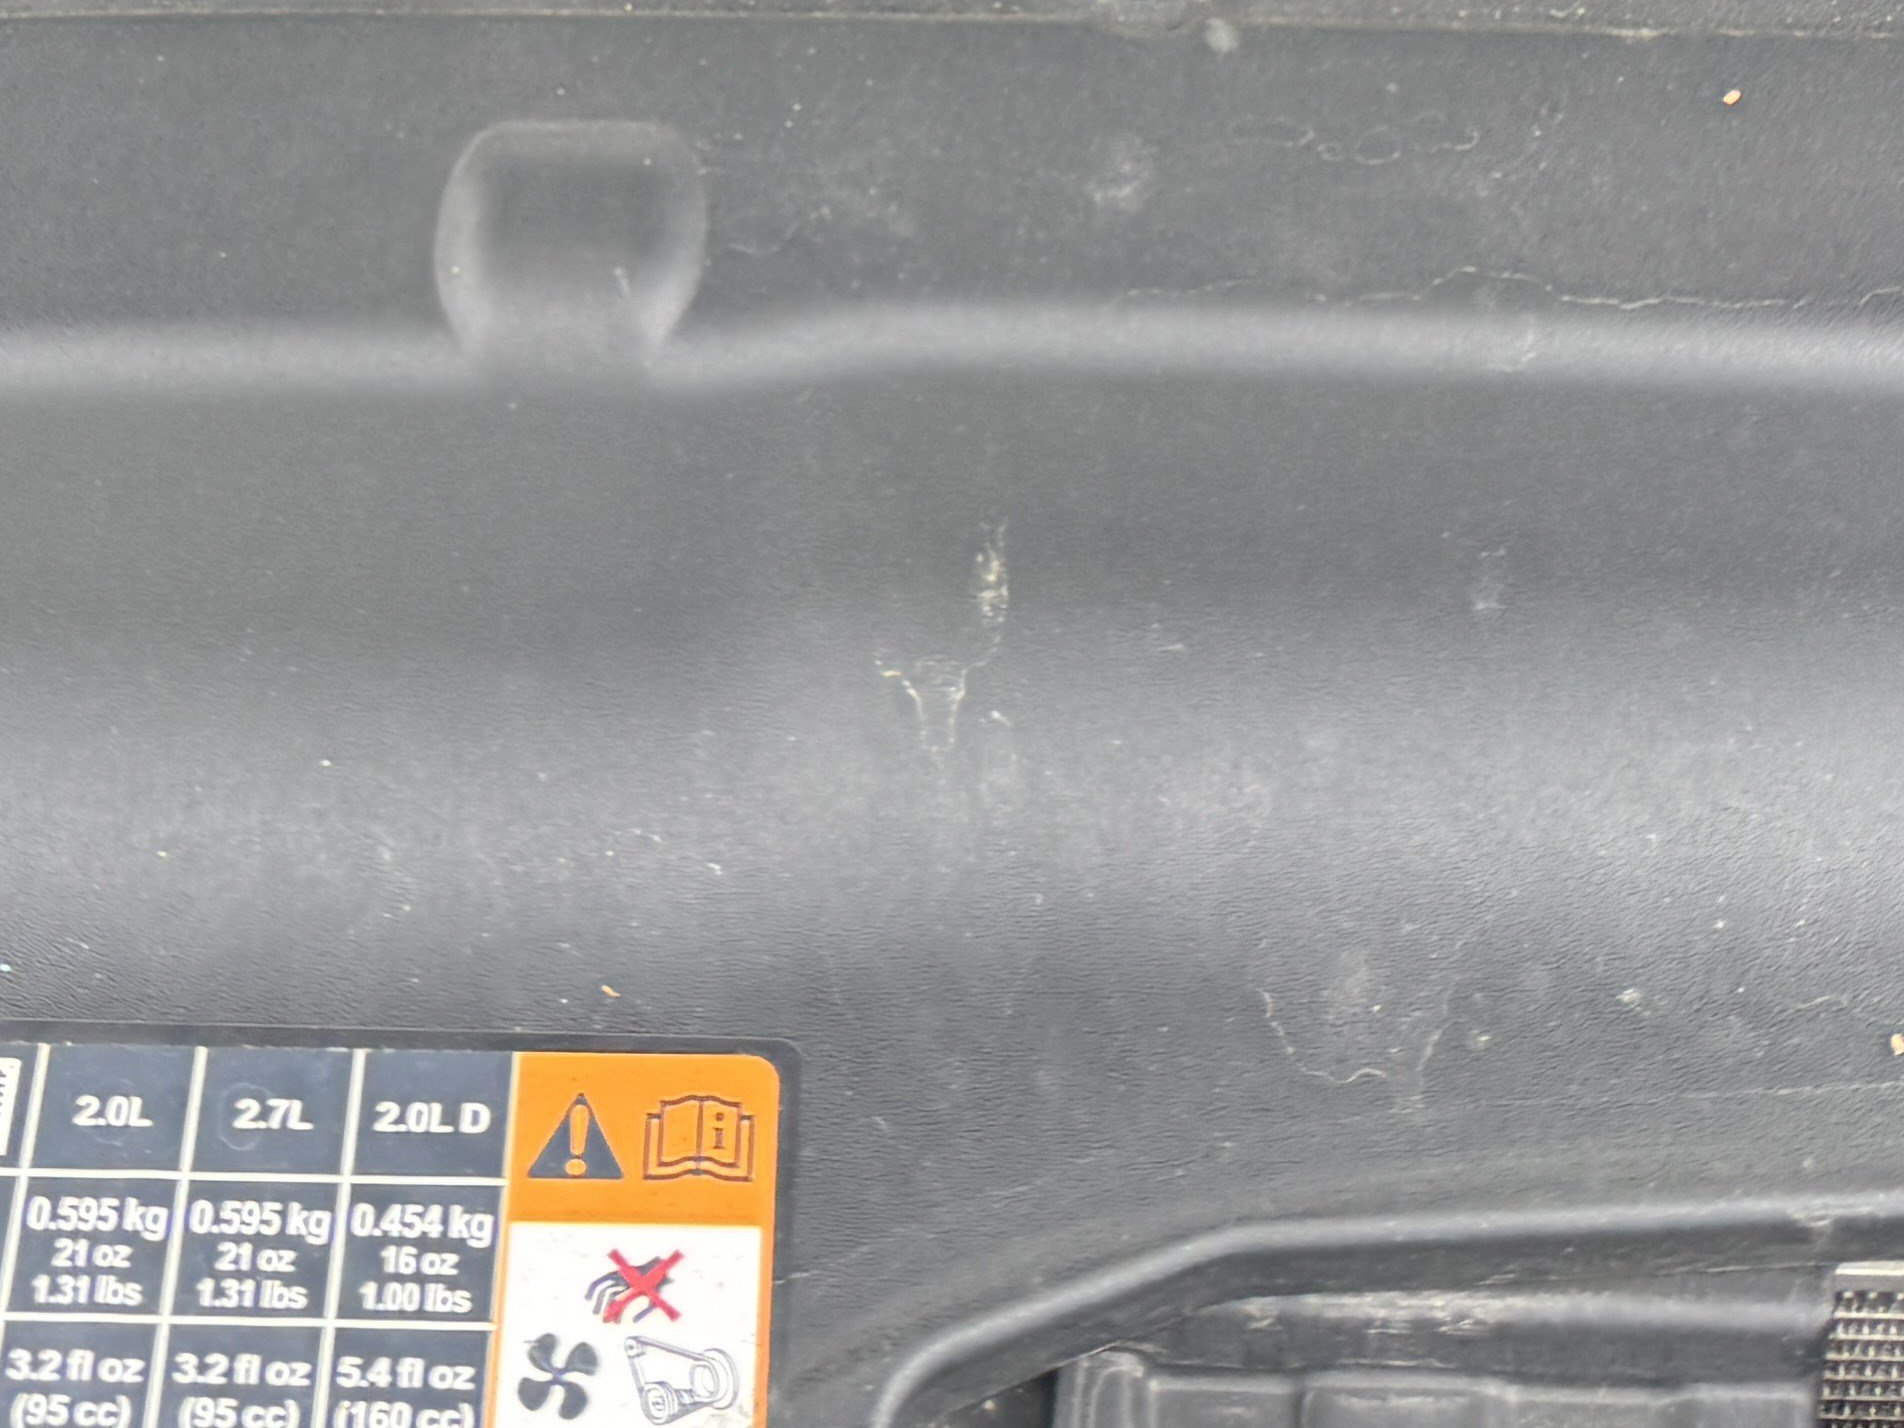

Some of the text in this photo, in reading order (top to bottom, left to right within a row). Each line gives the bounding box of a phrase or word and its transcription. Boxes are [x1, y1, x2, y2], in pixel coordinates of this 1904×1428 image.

[71, 1094, 153, 1128] 2.0L
[232, 1098, 313, 1131] 2.7L
[372, 1101, 491, 1133] 2.0L D
[26, 1195, 169, 1242] 0.595 kg
[188, 1199, 331, 1246] 0.595 kg
[352, 1204, 495, 1247] 0.454 kg
[51, 1238, 131, 1269] 21 oz
[214, 1242, 297, 1272] 21 oz
[381, 1246, 460, 1276] 16 oz
[32, 1275, 143, 1306] 1.31 lbs
[196, 1278, 309, 1310] 1.31 lbs
[359, 1282, 472, 1314] 1.00 lbs
[5, 1349, 146, 1384] 3.2 fl oz
[171, 1352, 312, 1388] 3.2 fl oz
[336, 1356, 477, 1391] 5.4 fl oz
[11, 1394, 132, 1428] (95 cc)
[178, 1397, 300, 1428] (95 cc)
[334, 1400, 475, 1428] (160 cc)
